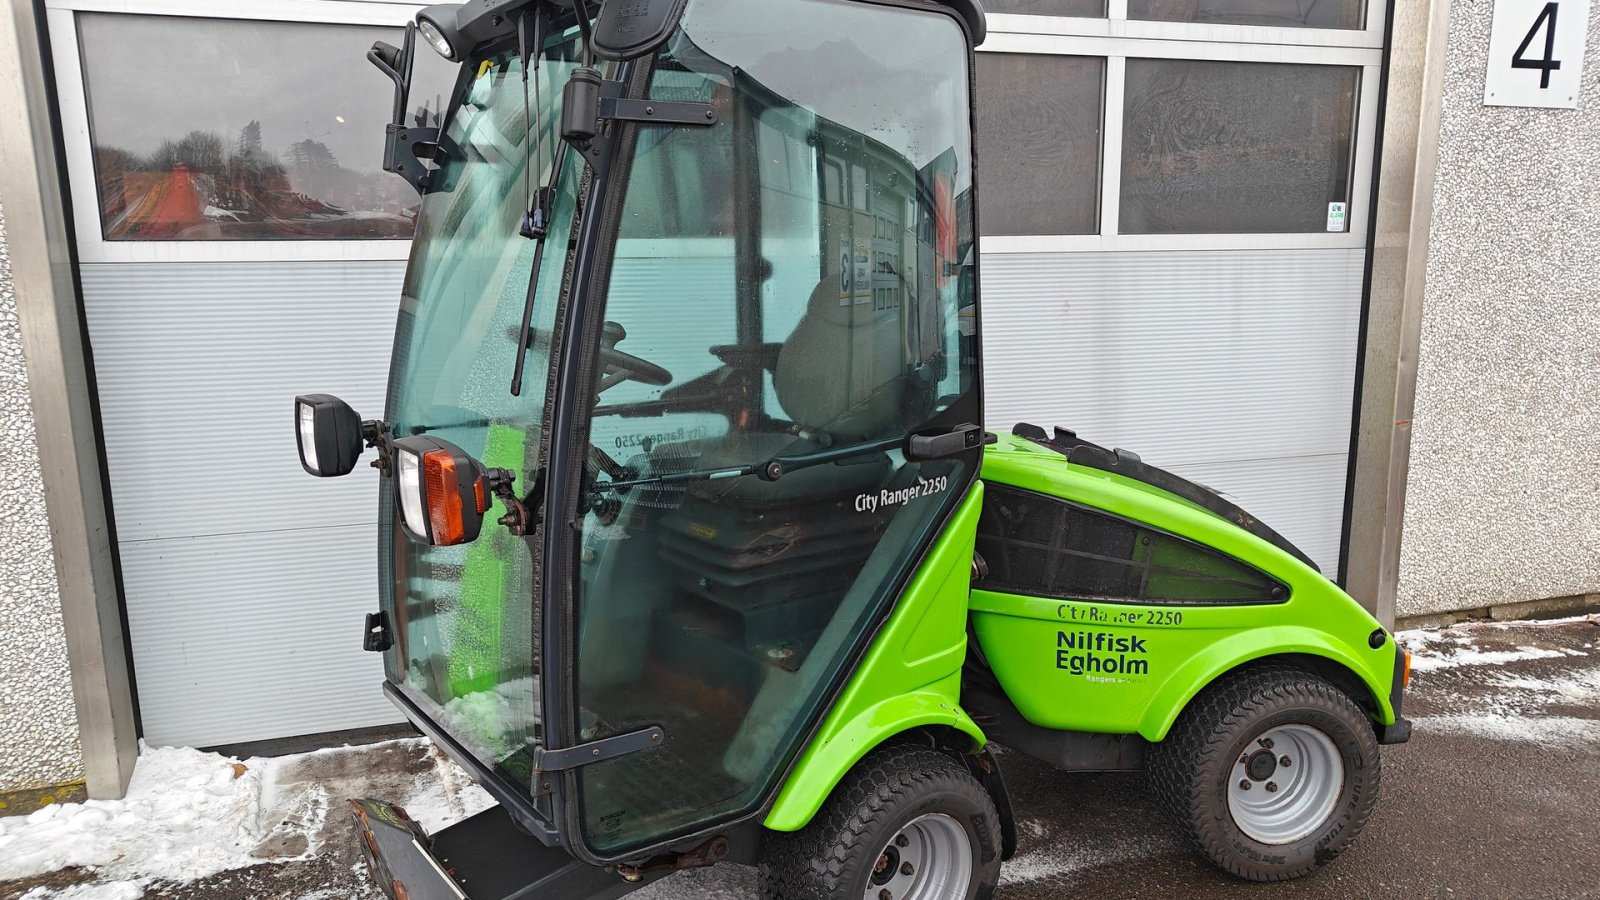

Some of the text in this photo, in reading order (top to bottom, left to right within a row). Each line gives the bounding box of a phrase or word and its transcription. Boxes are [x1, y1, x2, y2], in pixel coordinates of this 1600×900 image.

[1511, 2, 1561, 89] 4
[855, 476, 948, 513] City Ranger 2250
[1146, 610, 1183, 626] 2250
[1057, 631, 1147, 653] Nilfisk
[1056, 649, 1149, 676] Egholm
